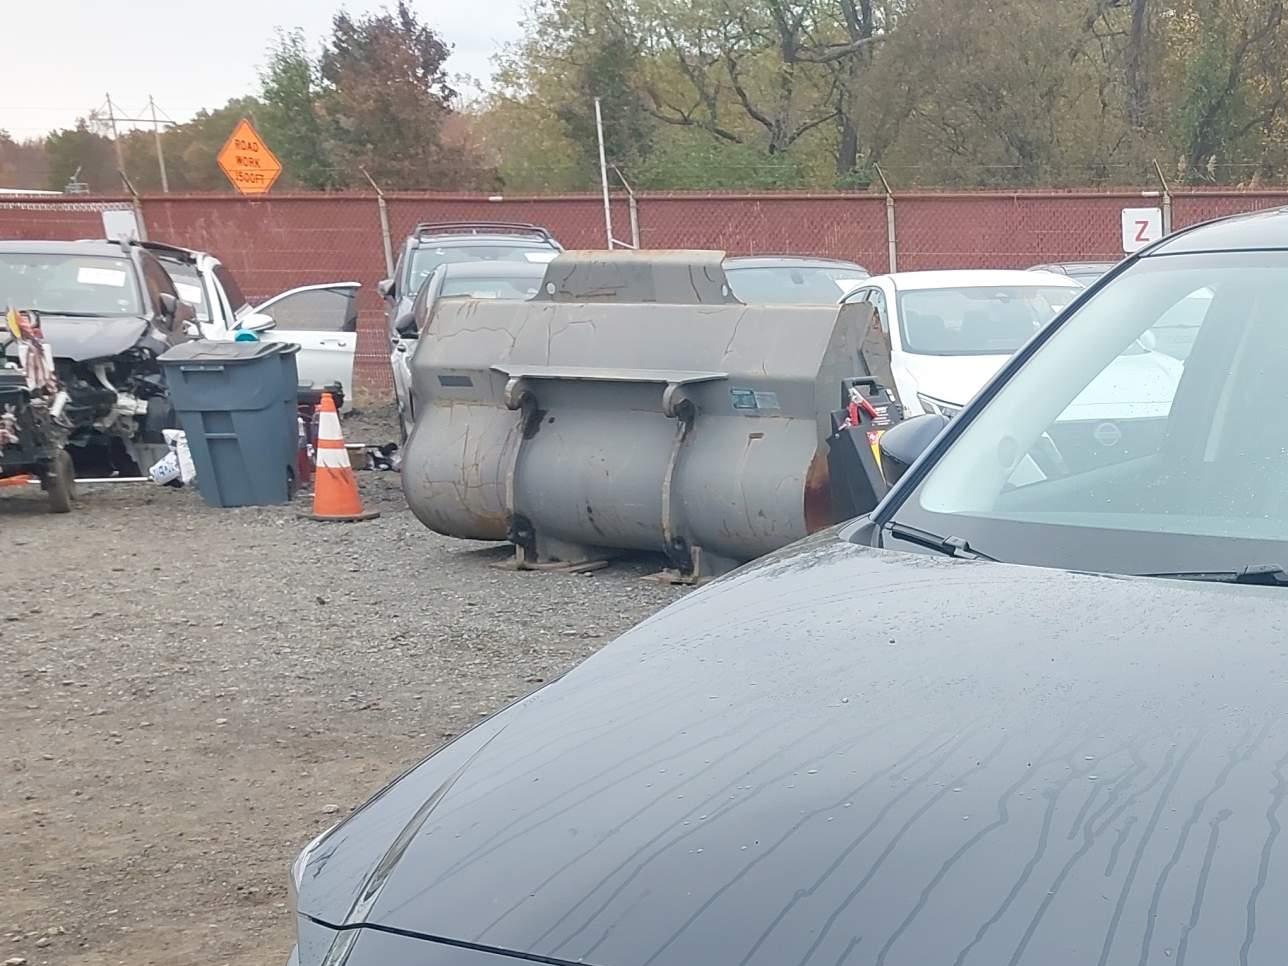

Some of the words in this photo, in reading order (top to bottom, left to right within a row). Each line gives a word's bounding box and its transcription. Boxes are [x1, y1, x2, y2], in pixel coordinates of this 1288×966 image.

[234, 139, 259, 152] ROAD
[236, 156, 261, 168] WORK
[1136, 221, 1150, 242] Z
